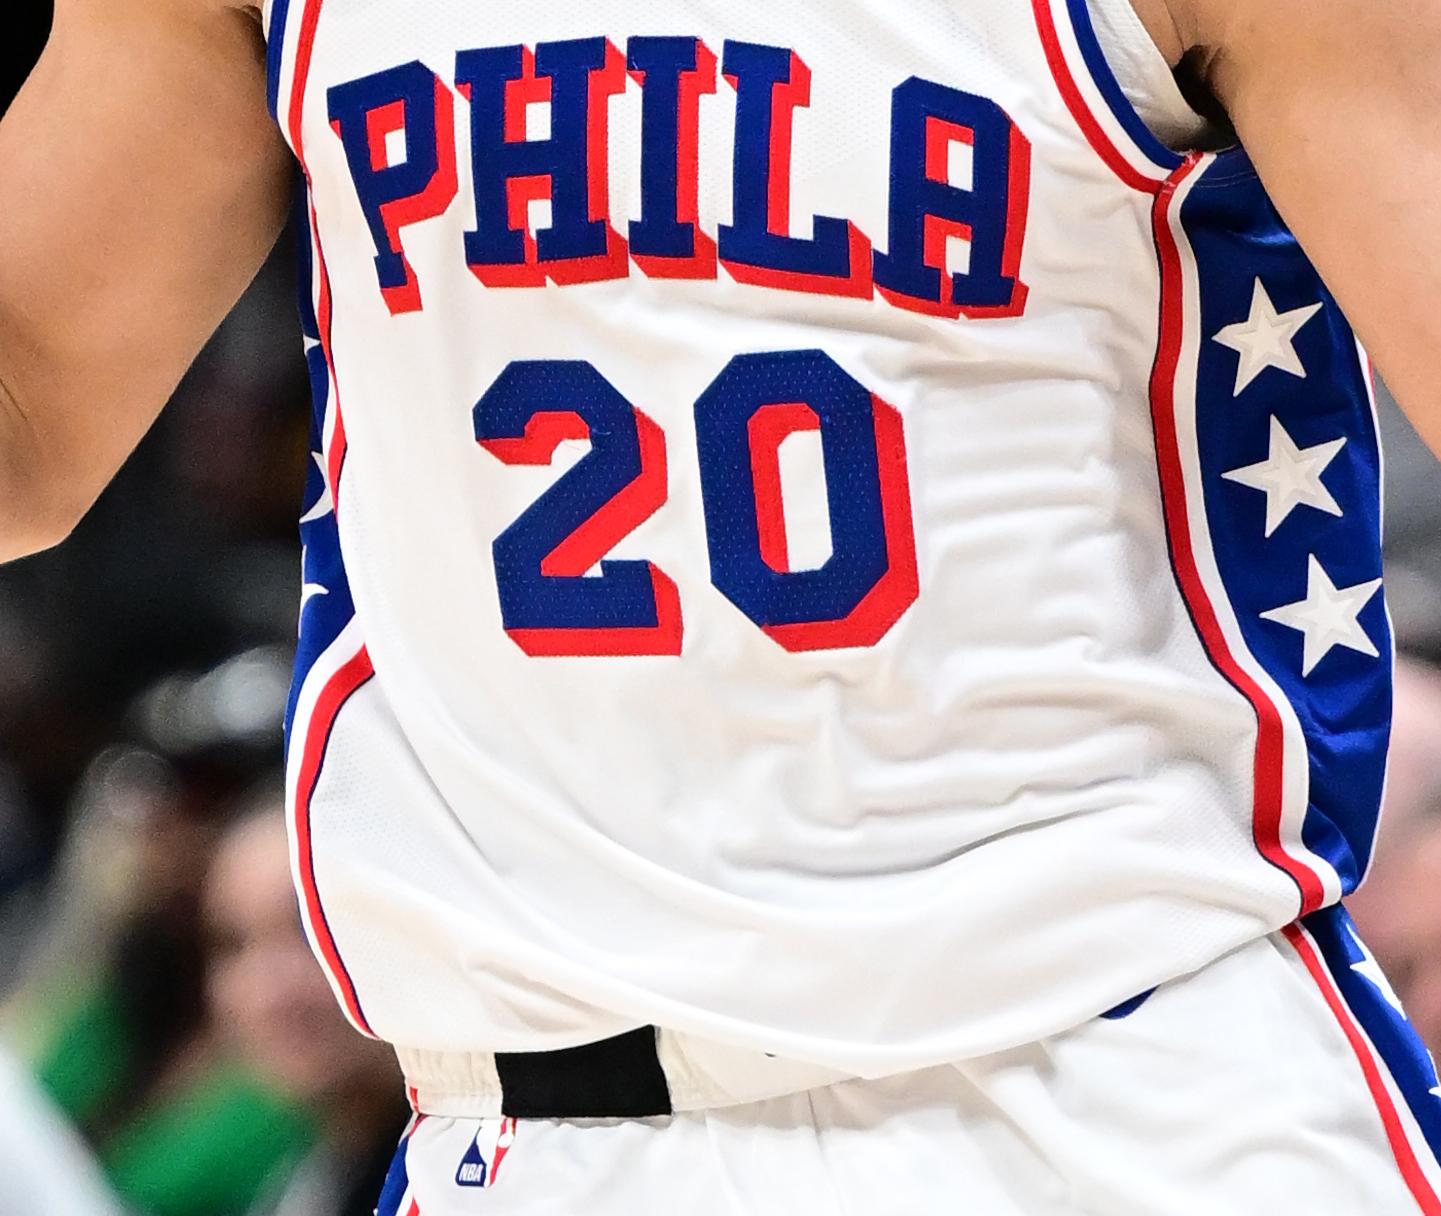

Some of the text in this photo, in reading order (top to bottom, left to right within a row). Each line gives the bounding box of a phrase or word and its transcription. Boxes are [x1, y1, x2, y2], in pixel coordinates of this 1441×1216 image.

[327, 35, 1032, 320] PHILA
[472, 348, 920, 657] 20
[458, 1163, 484, 1182] NBA
